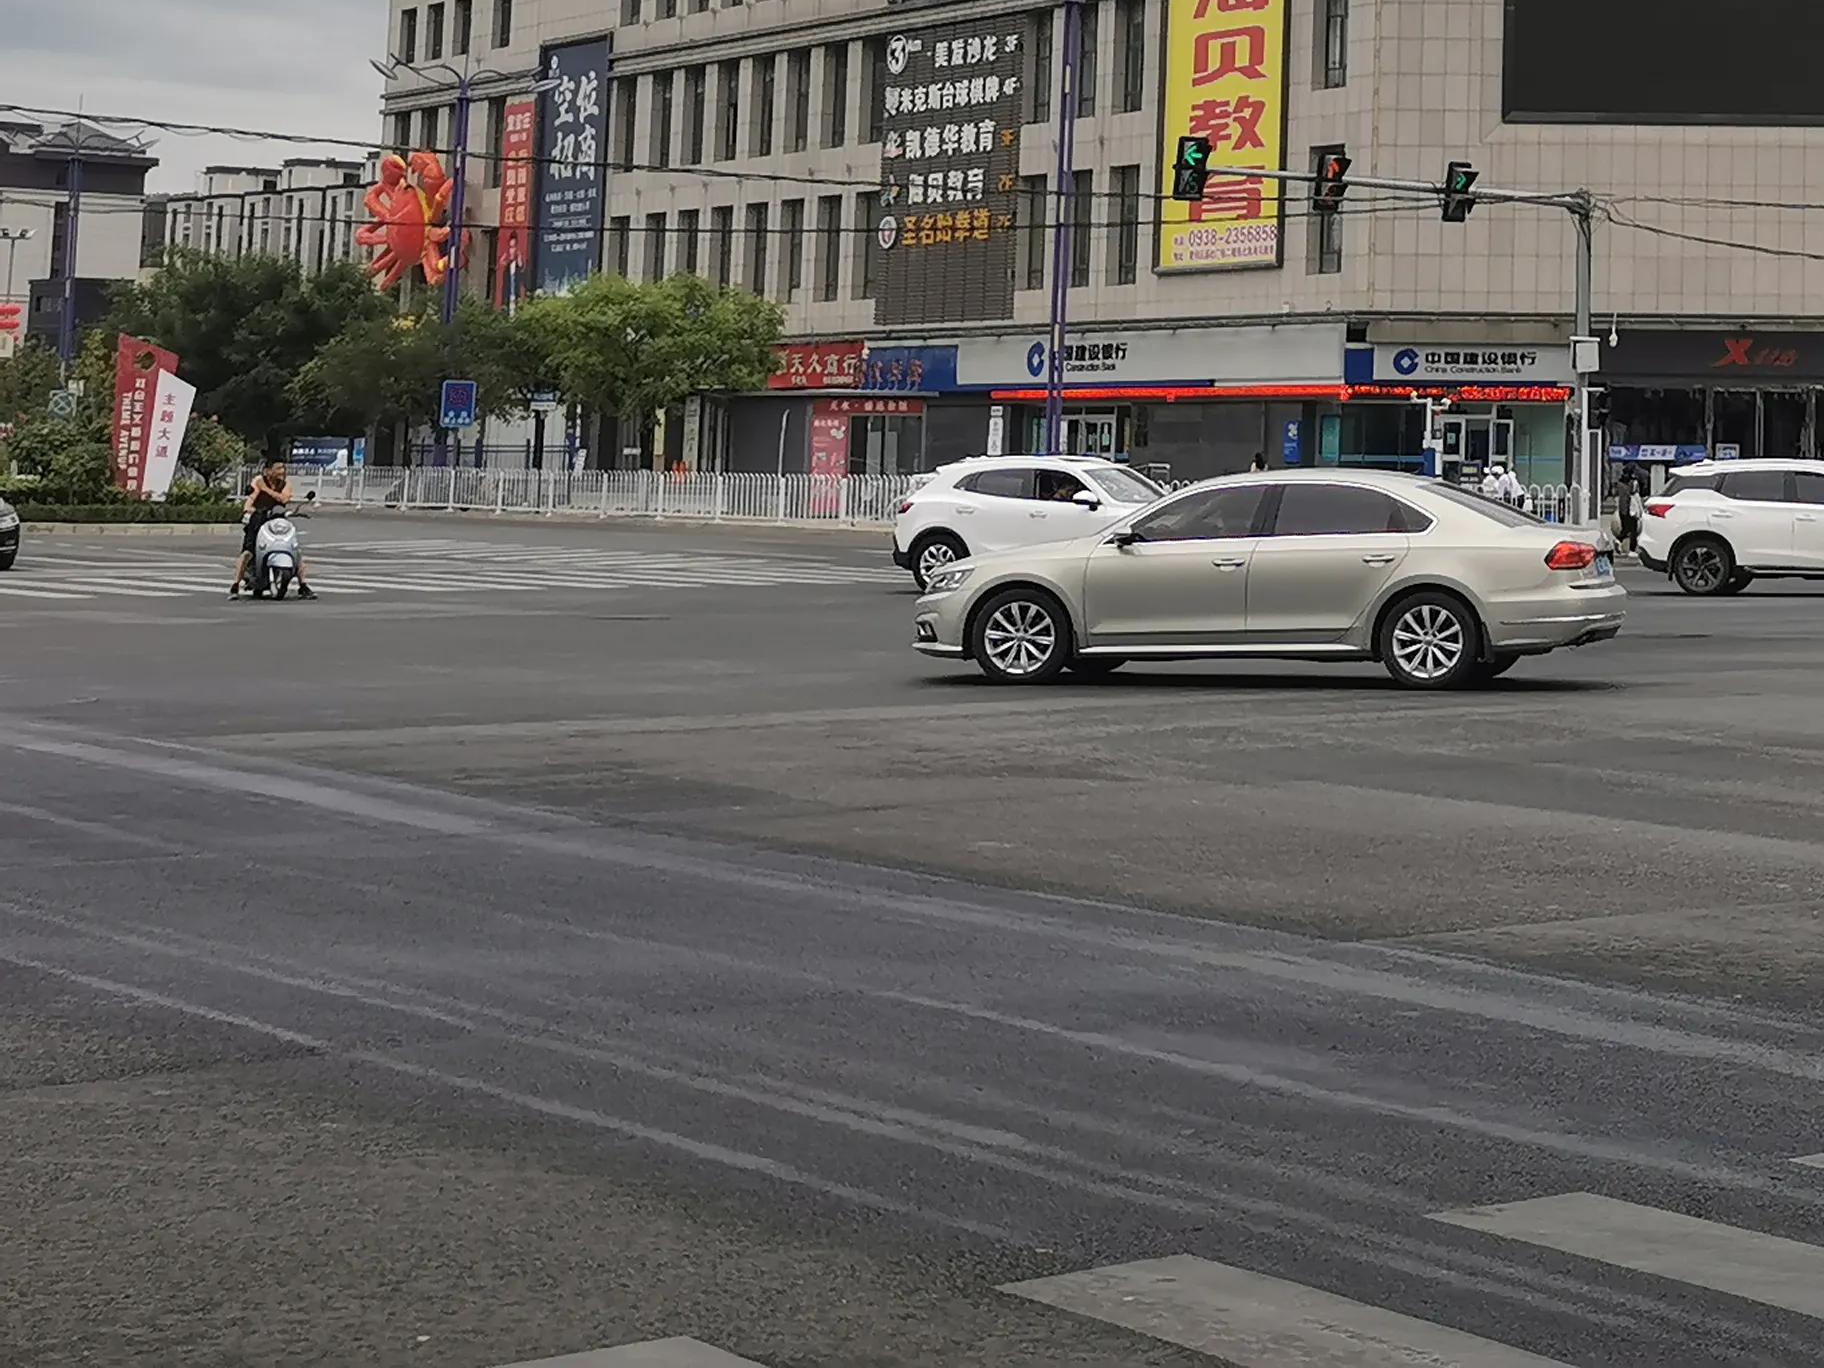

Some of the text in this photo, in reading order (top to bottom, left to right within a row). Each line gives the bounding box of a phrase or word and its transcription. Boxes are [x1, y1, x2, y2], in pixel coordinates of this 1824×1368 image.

[1052, 342, 1128, 363] 国建设银行
[1425, 351, 1537, 366] 中国建设银行
[1424, 365, 1522, 374] China Construction Bank
[155, 393, 177, 458] 主题大道
